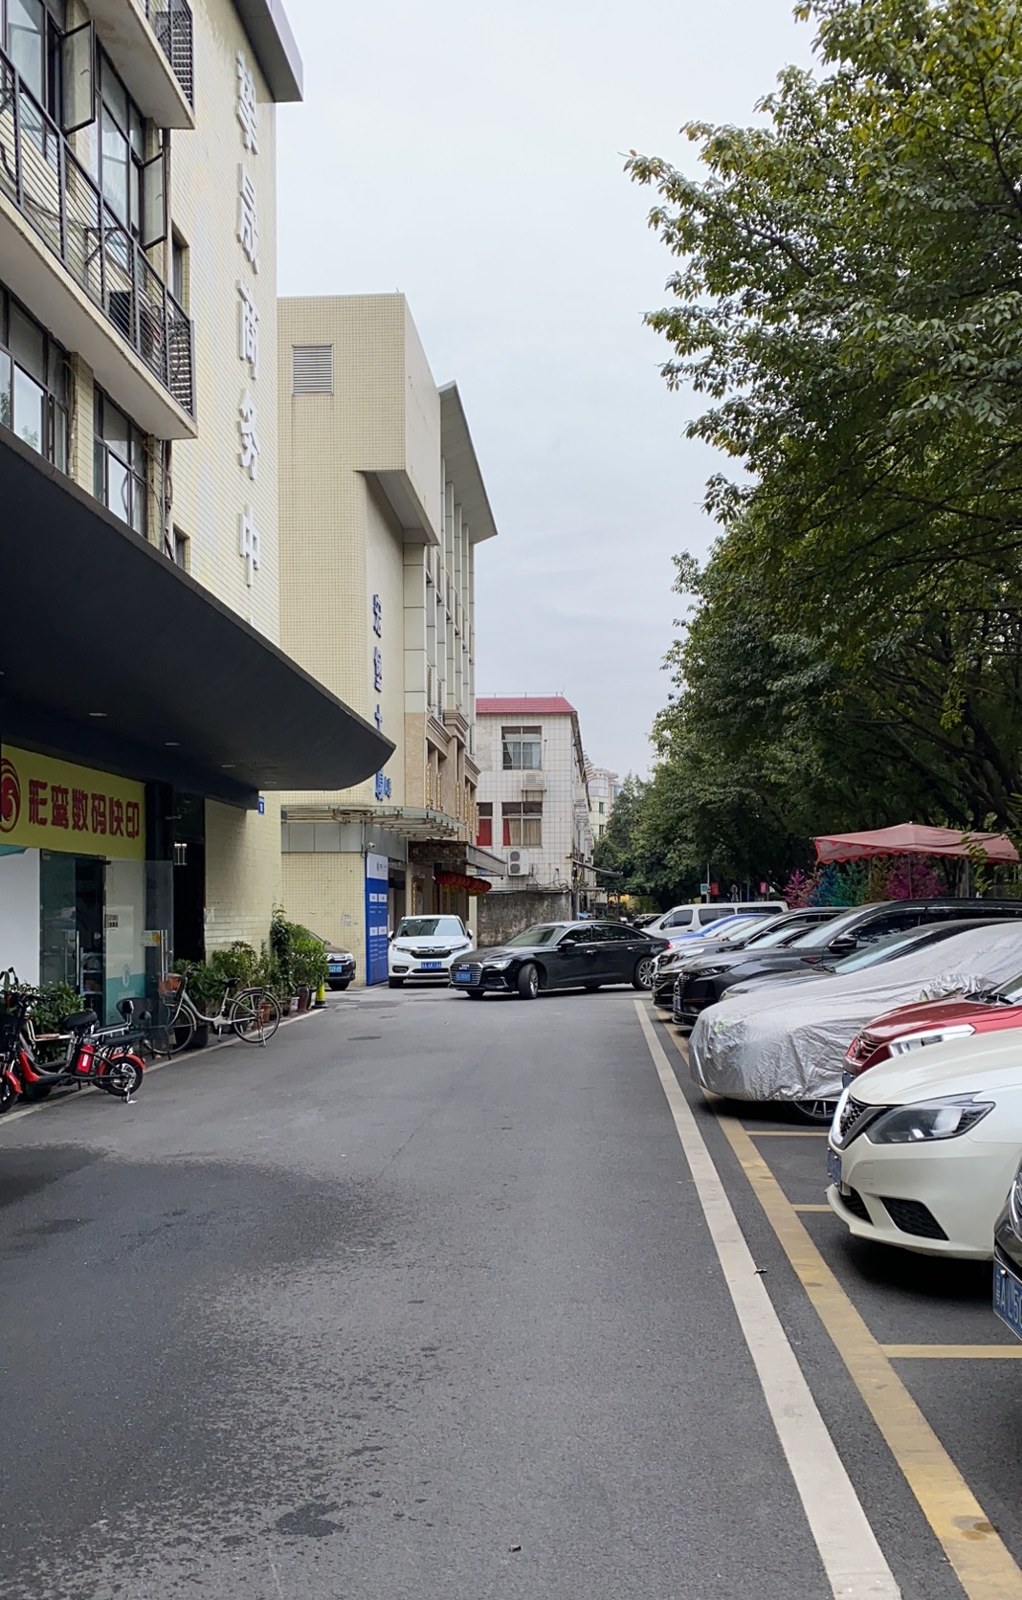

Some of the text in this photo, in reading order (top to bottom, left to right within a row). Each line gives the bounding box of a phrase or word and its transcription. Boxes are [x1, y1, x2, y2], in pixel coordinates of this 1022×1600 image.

[236, 52, 260, 622] 擎晟商务中
